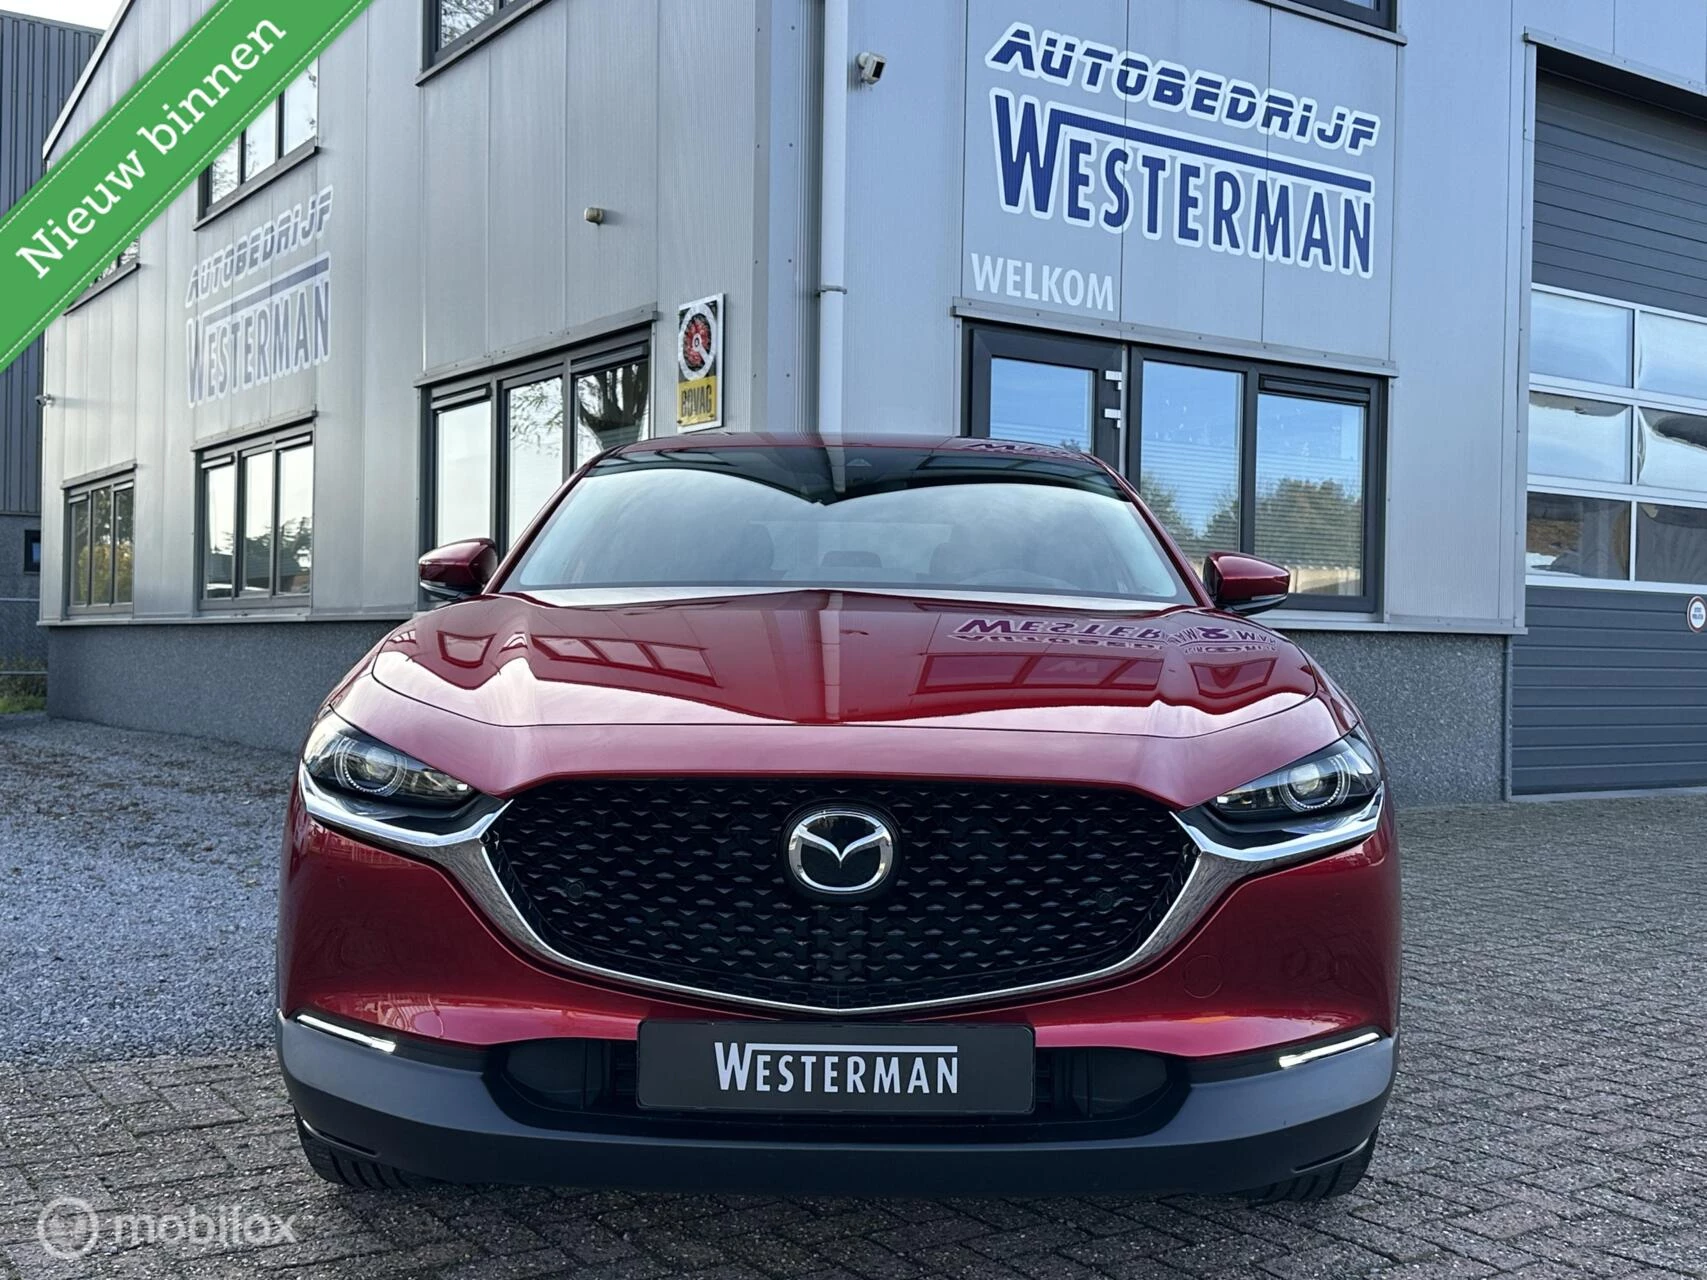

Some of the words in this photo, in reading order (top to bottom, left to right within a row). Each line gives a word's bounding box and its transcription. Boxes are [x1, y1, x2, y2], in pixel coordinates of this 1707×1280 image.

[994, 94, 1372, 274] WESTERMAN
[970, 252, 1114, 312] WELKOM
[186, 255, 331, 406] WESTERMAN
[680, 384, 712, 418] BOVAG
[713, 1041, 958, 1094] WESTERMAN
